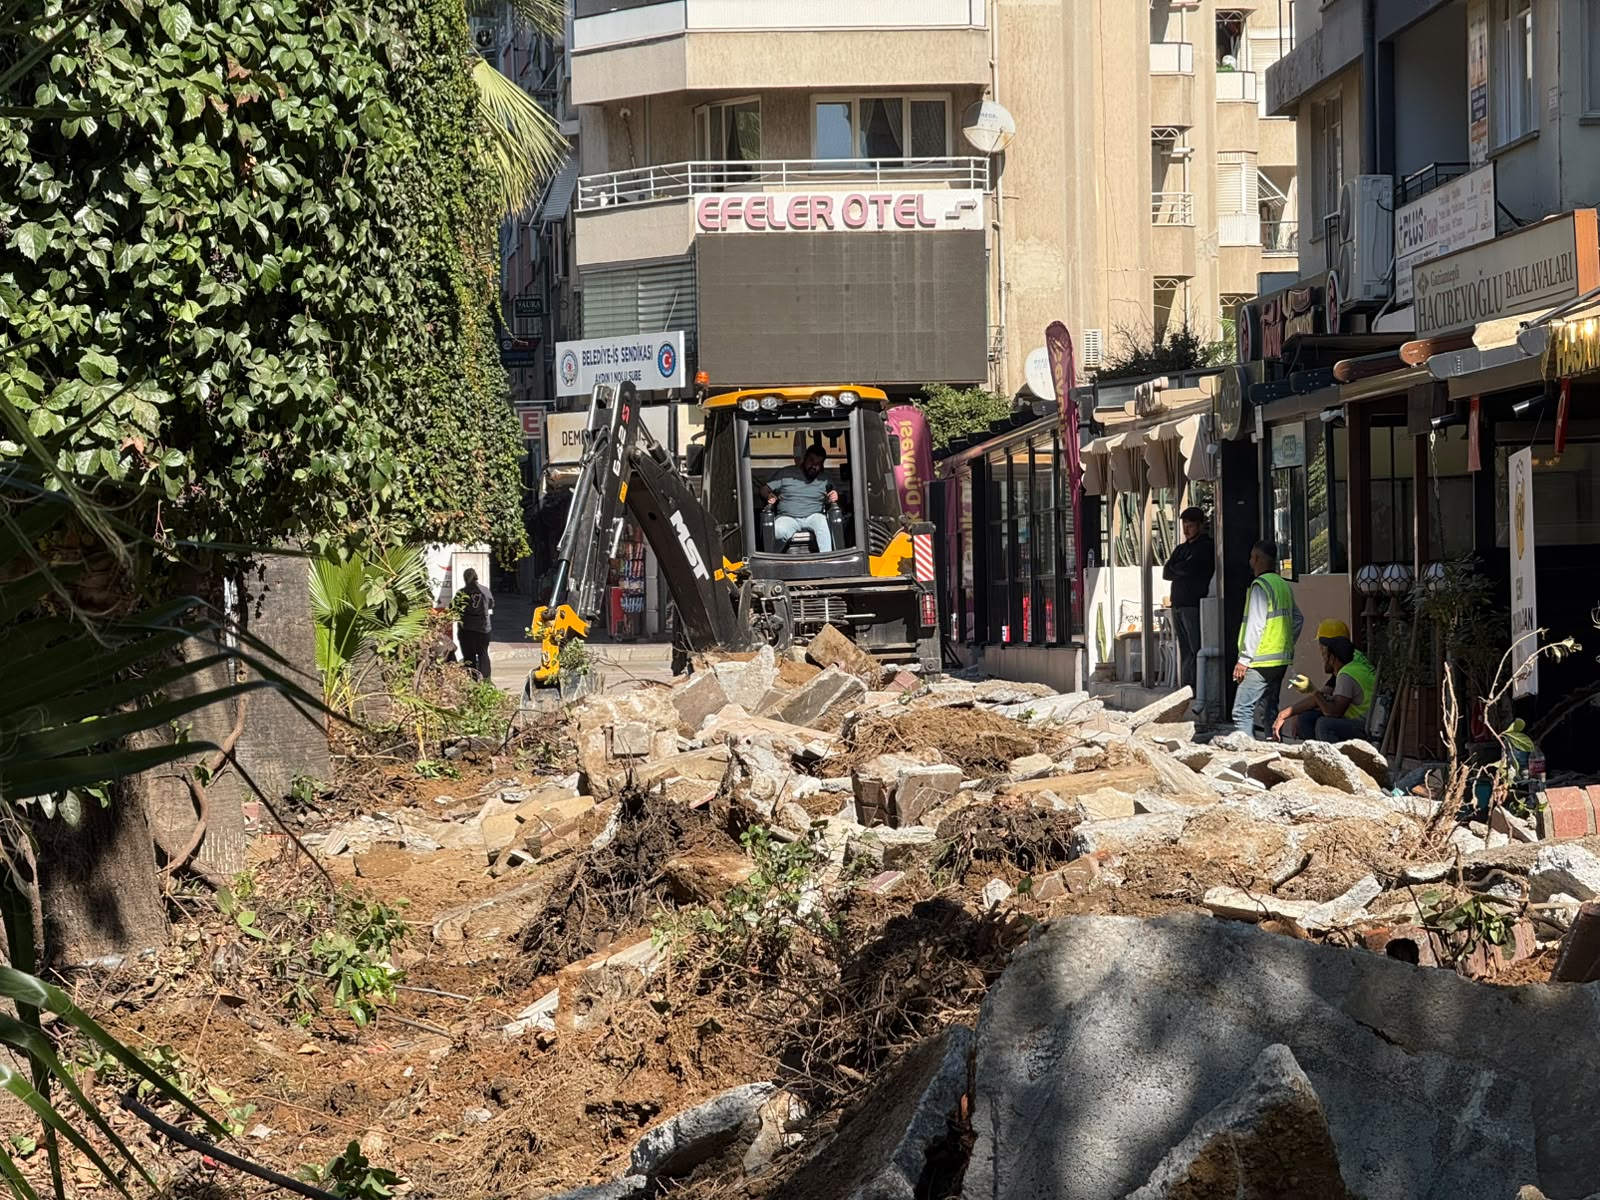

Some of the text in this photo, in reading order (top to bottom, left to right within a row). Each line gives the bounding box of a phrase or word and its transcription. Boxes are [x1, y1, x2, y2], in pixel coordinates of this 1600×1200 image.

[698, 194, 936, 231] EFELER OTEL
[1418, 269, 1503, 333] HACIBEYOĞLU
[1506, 251, 1574, 299] BAKLAVALARI
[621, 342, 653, 363] SENDİKASI
[670, 509, 710, 581] MST
